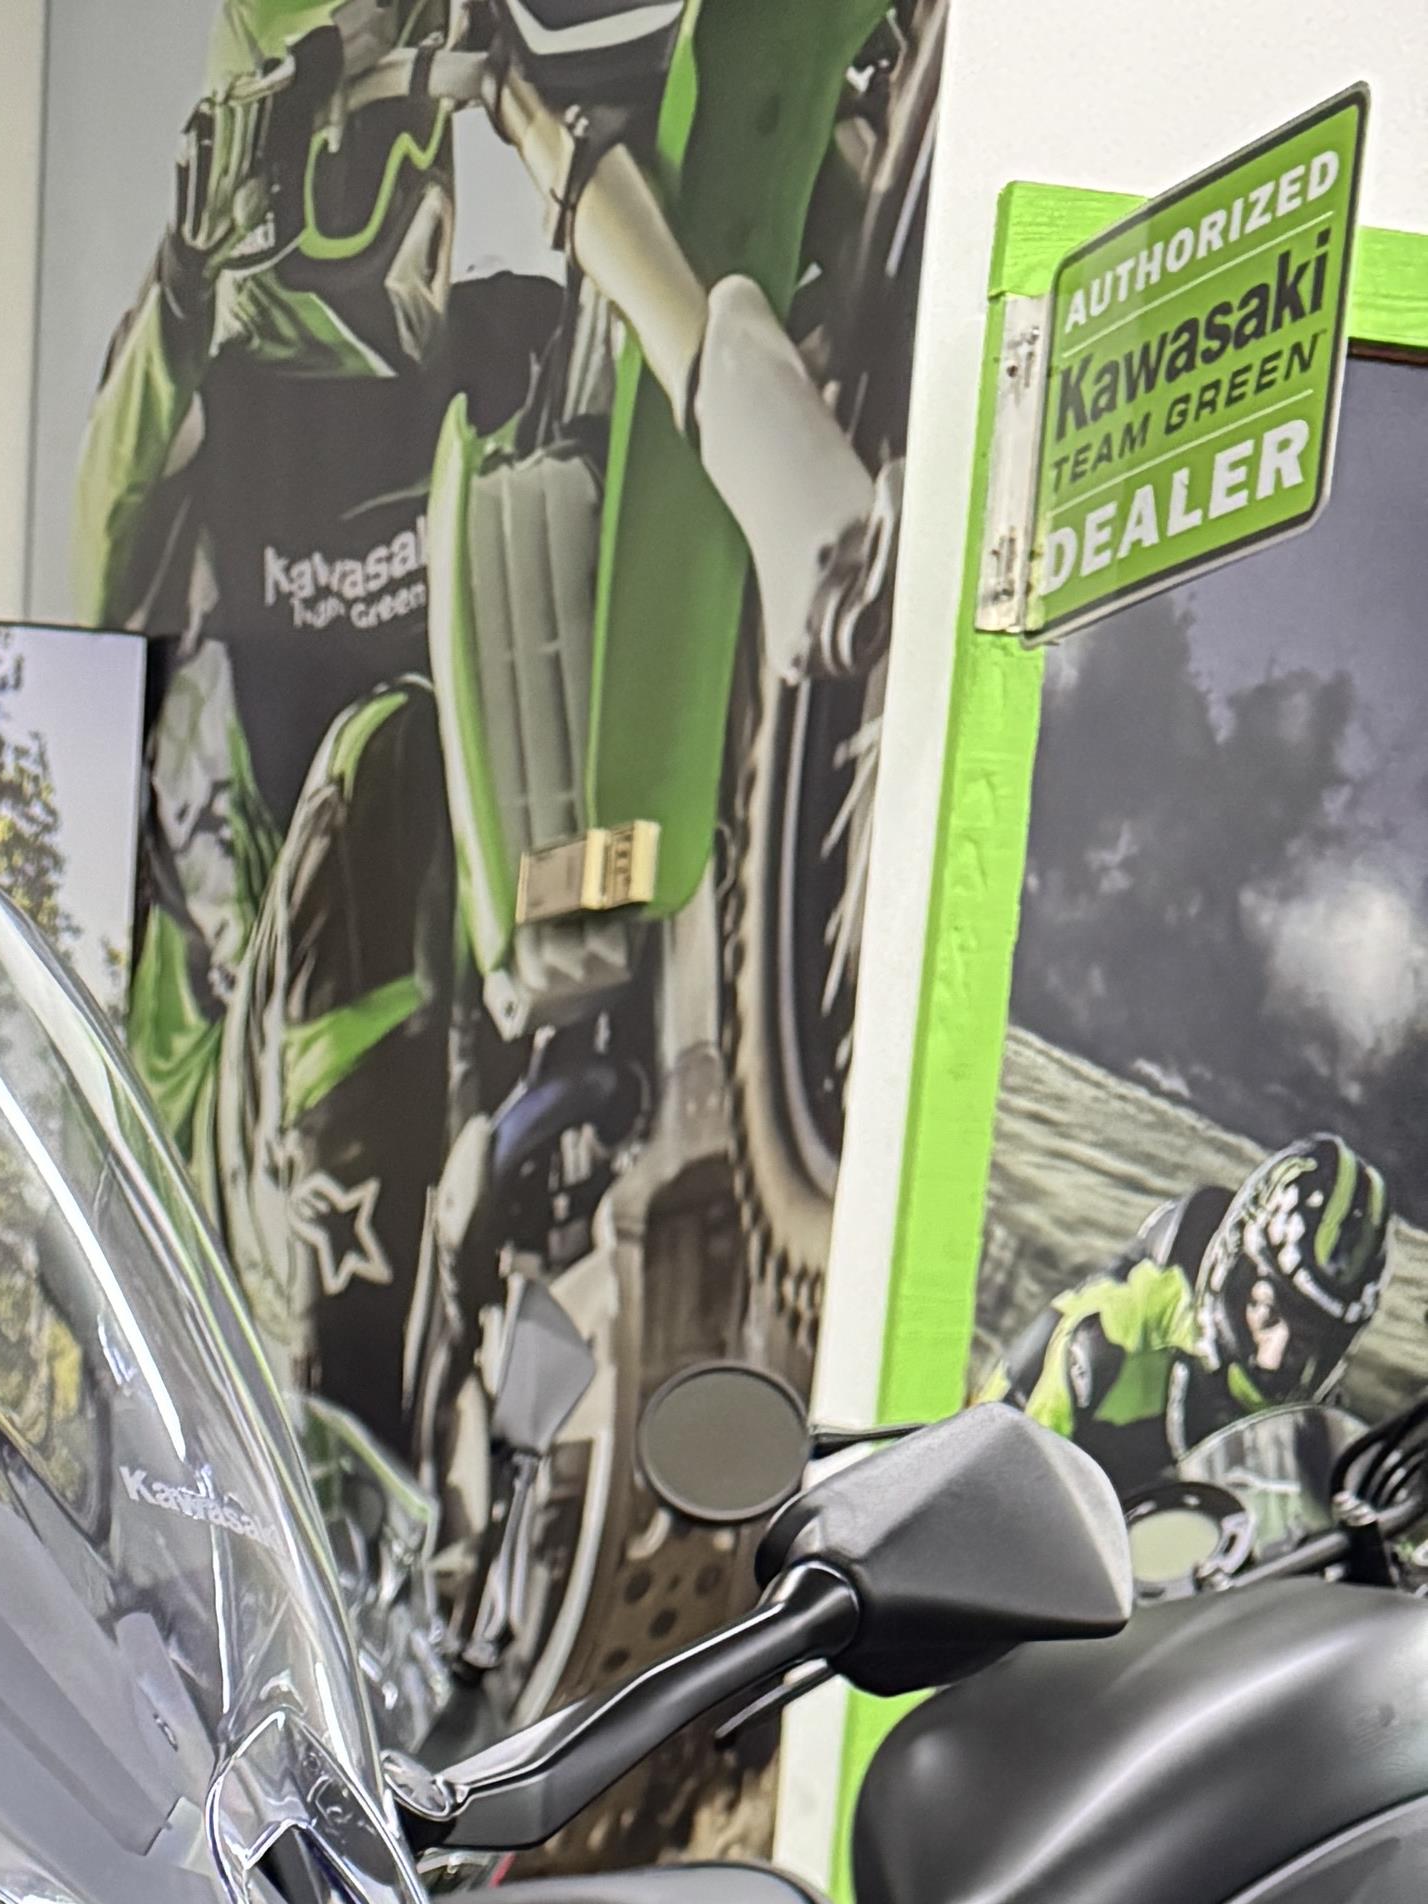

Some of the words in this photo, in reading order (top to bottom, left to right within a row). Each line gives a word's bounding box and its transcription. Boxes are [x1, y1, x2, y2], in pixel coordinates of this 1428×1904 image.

[1063, 150, 1341, 333] AUTHORIZED
[1055, 230, 1331, 442] Kawasaki
[1040, 418, 1311, 597] DEALER
[1050, 408, 1147, 493] TEAM
